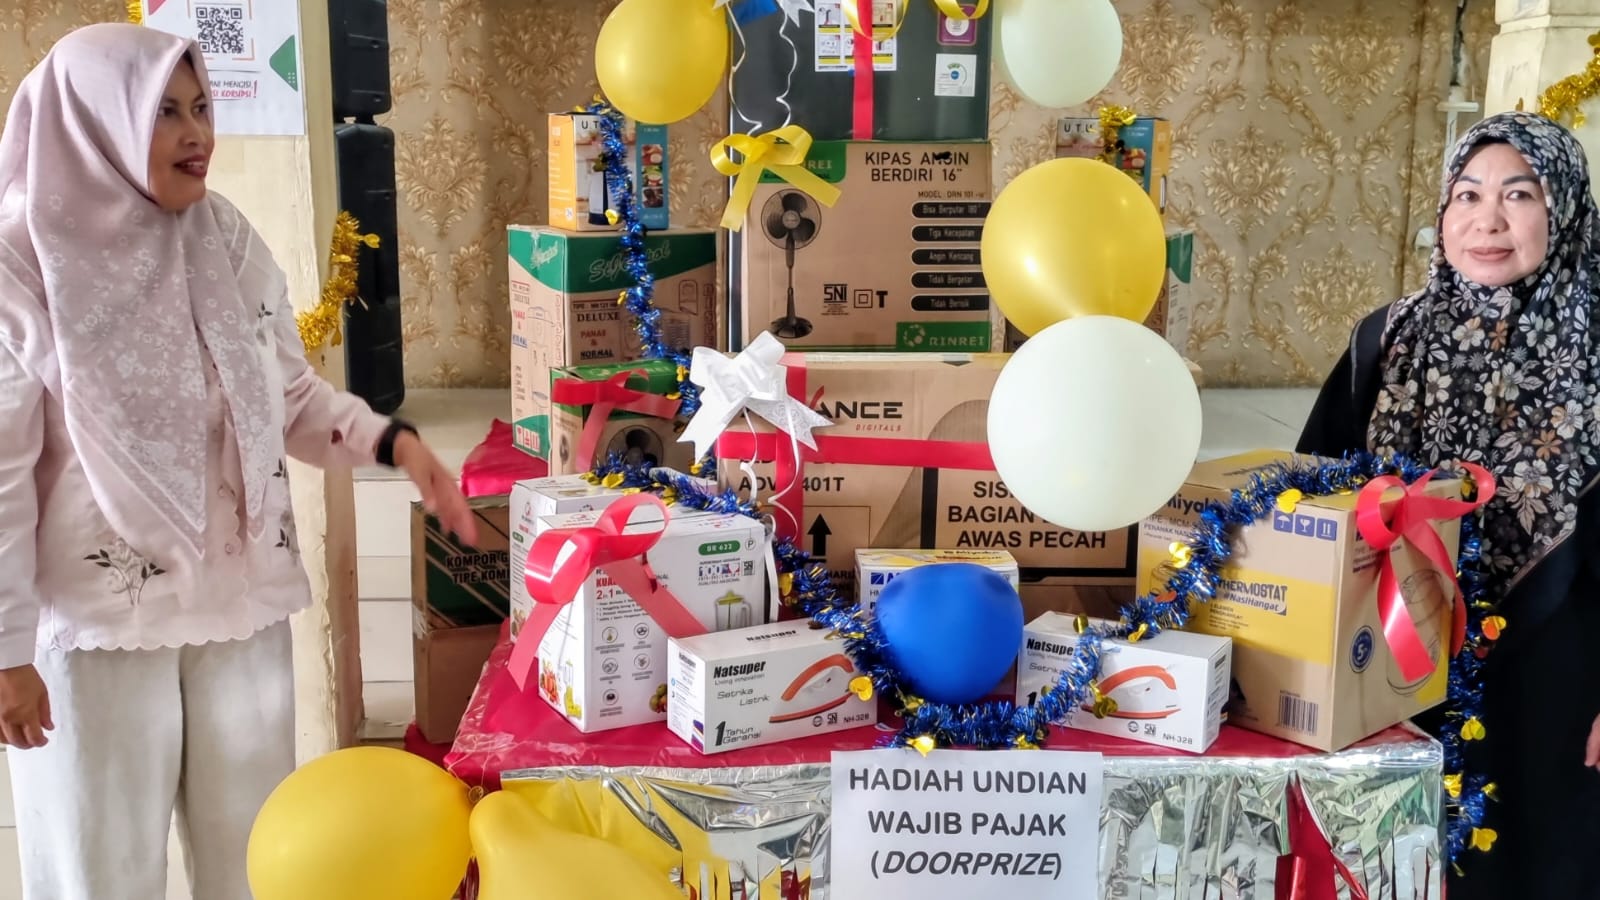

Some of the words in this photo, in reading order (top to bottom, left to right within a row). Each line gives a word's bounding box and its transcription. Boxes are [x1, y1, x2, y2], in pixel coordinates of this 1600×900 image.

[865, 151, 912, 165] KIPAS
[871, 168, 933, 182] BERDIRI
[824, 284, 848, 303] SNI
[576, 311, 621, 322] DELUXE
[929, 335, 985, 346] RINREI
[855, 424, 902, 432] DIGITALS
[973, 480, 1014, 499] SIS
[948, 505, 1035, 524] BAGIAN
[956, 530, 1022, 548] AWAS
[1028, 530, 1106, 549] PECAH
[446, 552, 497, 569] KOMPOR
[451, 571, 478, 584] TIPE
[1217, 578, 1288, 602] THERMOSTAT
[1026, 637, 1075, 656] Natsupe
[713, 660, 767, 679] Natsuper
[1029, 662, 1059, 674] Setrik
[717, 688, 754, 700] Setrika
[714, 720, 726, 746] 1
[725, 726, 754, 737] Tahun
[849, 767, 964, 793] HADIAH
[972, 770, 1087, 795] UNDIAN
[868, 810, 963, 835] WAJIB
[971, 812, 1067, 837] PAJAK
[870, 849, 1063, 880] (DOORPRIZE)
